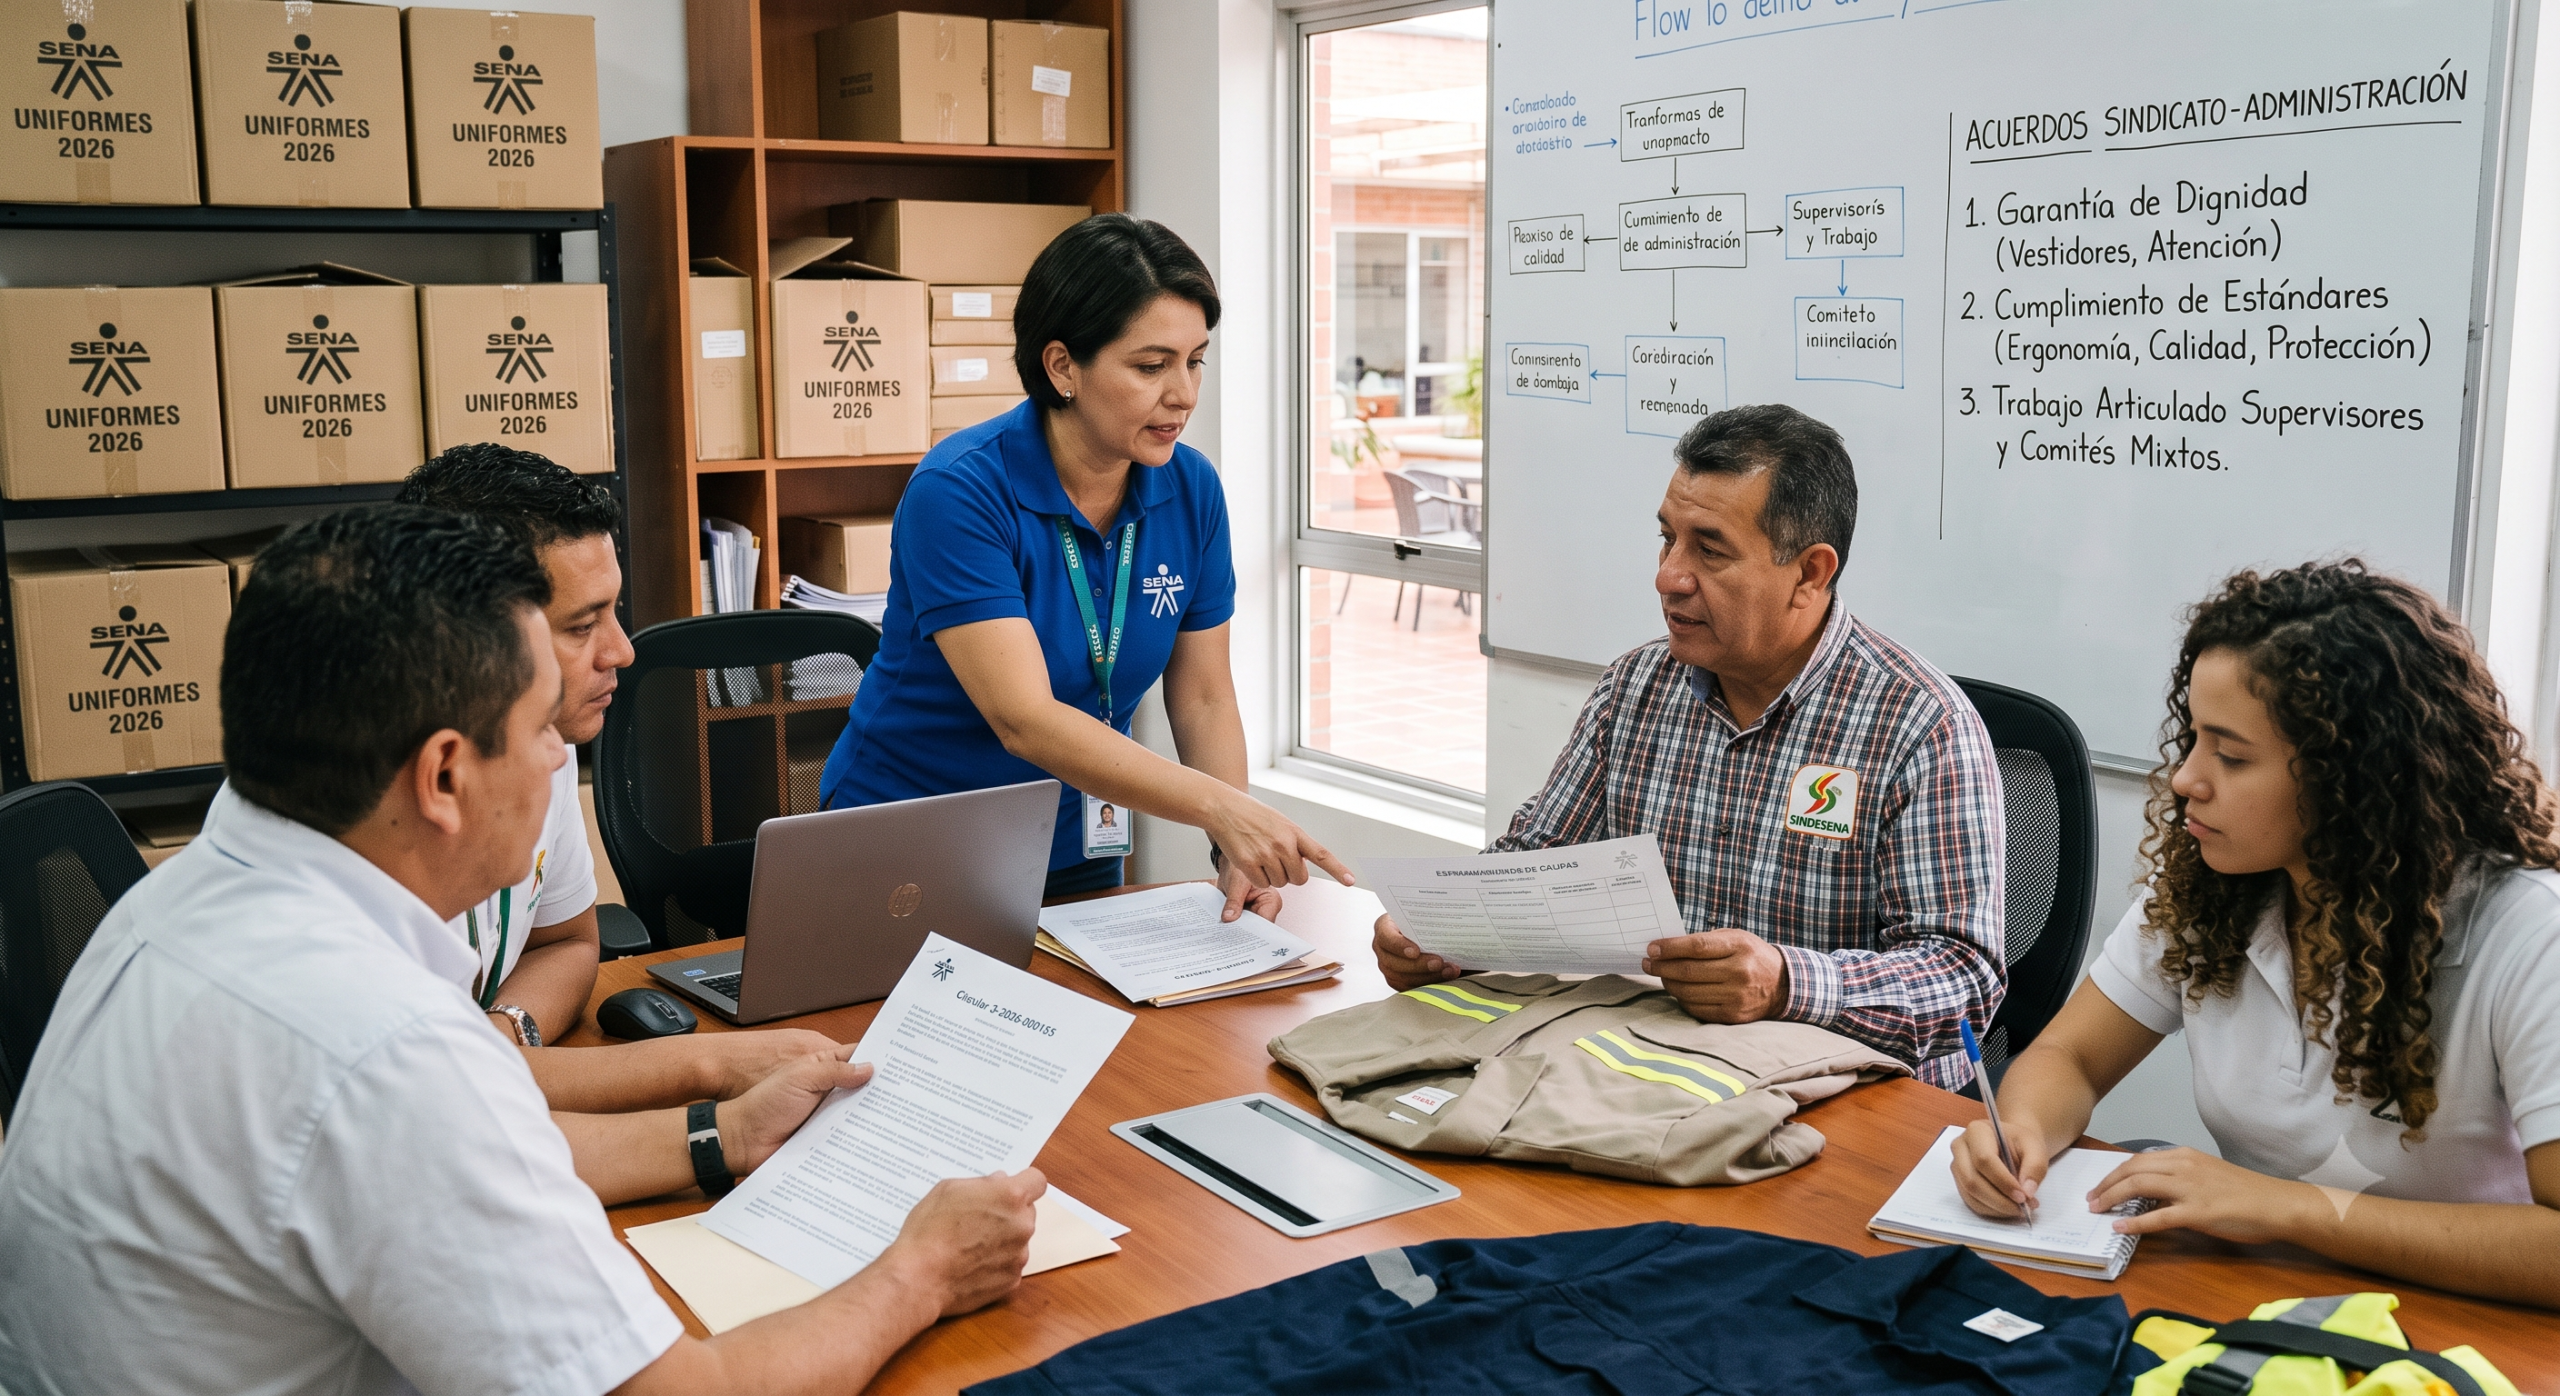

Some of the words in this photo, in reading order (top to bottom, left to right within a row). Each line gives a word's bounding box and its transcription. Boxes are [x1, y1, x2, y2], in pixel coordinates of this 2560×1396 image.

[1636, 0, 1690, 40] Flow
[38, 41, 120, 60] SENA
[266, 51, 341, 67] SENA
[473, 61, 542, 77] SENA
[15, 108, 152, 133] UNIFORMES
[1572, 111, 1586, 127] de
[1626, 107, 1700, 128] Tranformas
[1708, 101, 1724, 119] de
[245, 115, 369, 138] UNIFORMES
[453, 124, 567, 144] UNIFORMES
[1966, 111, 2088, 151] ACUERDOS
[59, 137, 114, 159] 2026
[284, 142, 335, 162] 2026
[488, 148, 534, 167] 2026
[1966, 198, 1985, 227] 1.
[1998, 187, 2114, 225] Garantía
[2130, 184, 2160, 216] de
[2177, 171, 2307, 227] Dignidad
[1707, 206, 1722, 222] de
[1793, 199, 1884, 224] Supervisorís
[1560, 224, 1573, 240] de
[1624, 237, 1638, 252] de
[1645, 231, 1740, 251] administración
[1807, 236, 1814, 253] y
[1821, 227, 1877, 251] Trabajo
[1997, 235, 2136, 272] (Vestidores,
[2148, 216, 2281, 262] Atención)
[1524, 248, 1564, 265] calidad
[1961, 292, 1983, 320] 2.
[1995, 284, 2163, 327] Cumplimiento
[2179, 283, 2208, 313] de
[2225, 277, 2388, 312] Estándares
[1807, 304, 1875, 323] Comiteto
[286, 332, 357, 346] SENA
[487, 333, 552, 346] SENA
[824, 326, 880, 338] SENA
[69, 341, 150, 355] SENA
[1995, 330, 2139, 373] (Ergonomía,
[2150, 329, 2255, 365] Calidad,
[2268, 318, 2430, 366] Protección)
[805, 381, 900, 398] UNIFORMES
[1516, 373, 1529, 387] de
[1670, 379, 1676, 394] y
[264, 393, 386, 415] UNIFORMES
[466, 391, 578, 412] UNIFORMES
[833, 402, 872, 419] 2026
[1960, 388, 1980, 415] 3.
[1992, 385, 2082, 428] Trabajo
[2096, 387, 2226, 423] Articulado
[2242, 390, 2423, 436] Supervisores
[46, 405, 179, 428] UNIFORMES
[501, 416, 546, 434] 2026
[303, 418, 352, 438] 2026
[89, 432, 142, 452] 2026
[1997, 441, 2007, 469] y
[2021, 430, 2115, 465] Comités
[2132, 435, 2228, 471] Mixtos.
[1142, 574, 1184, 588] SENA
[90, 622, 167, 640] SENA
[68, 681, 201, 713] UNIFORMES
[109, 710, 163, 734] 2026
[1789, 814, 1850, 834] SINDESENA
